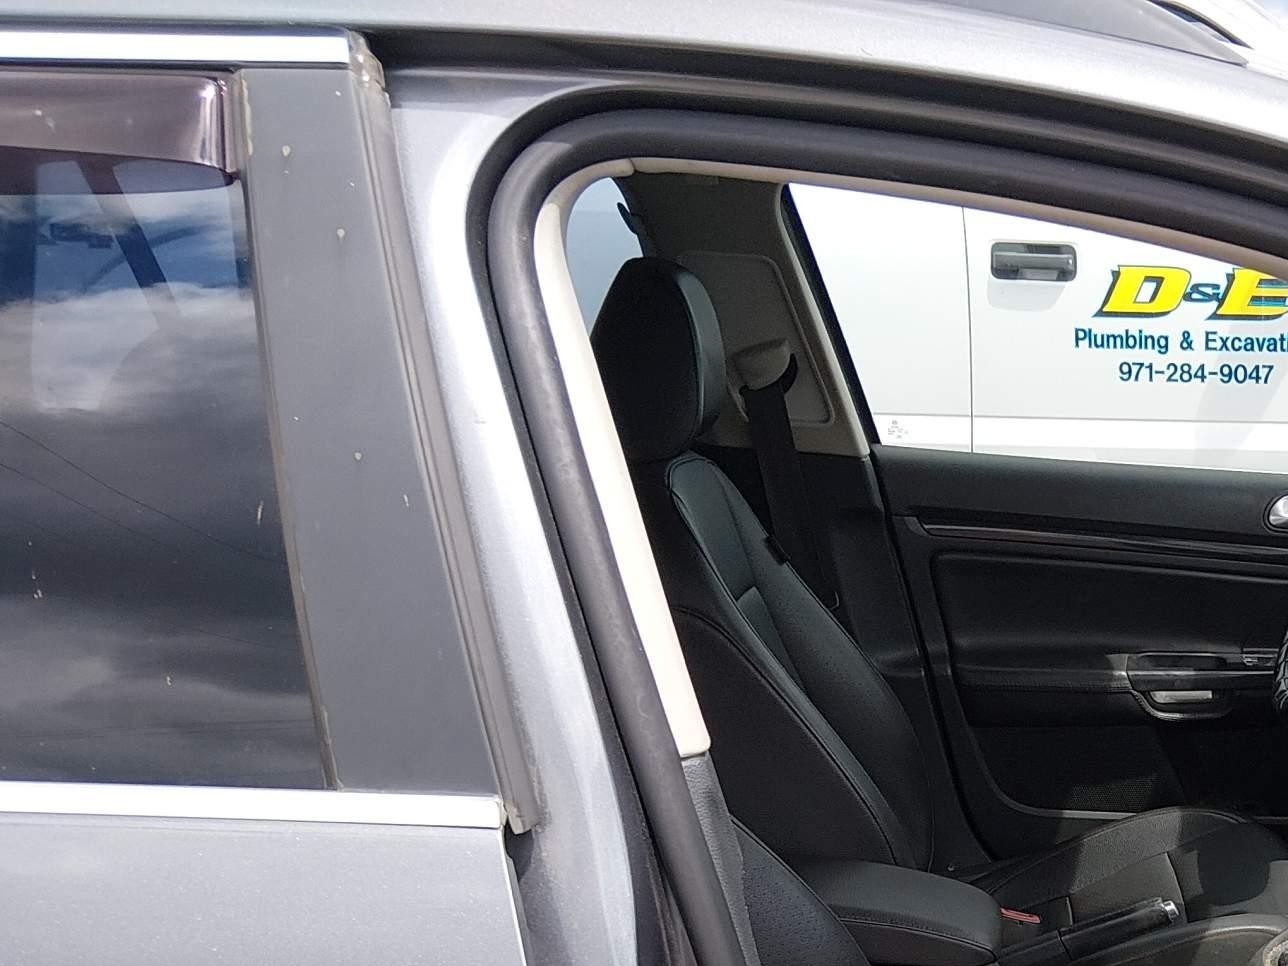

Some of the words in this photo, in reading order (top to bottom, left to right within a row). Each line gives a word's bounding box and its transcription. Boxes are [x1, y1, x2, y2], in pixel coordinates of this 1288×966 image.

[1074, 328, 1169, 355] Plumbing
[1179, 330, 1194, 351] &
[1118, 361, 1274, 385] 971-284-9047
